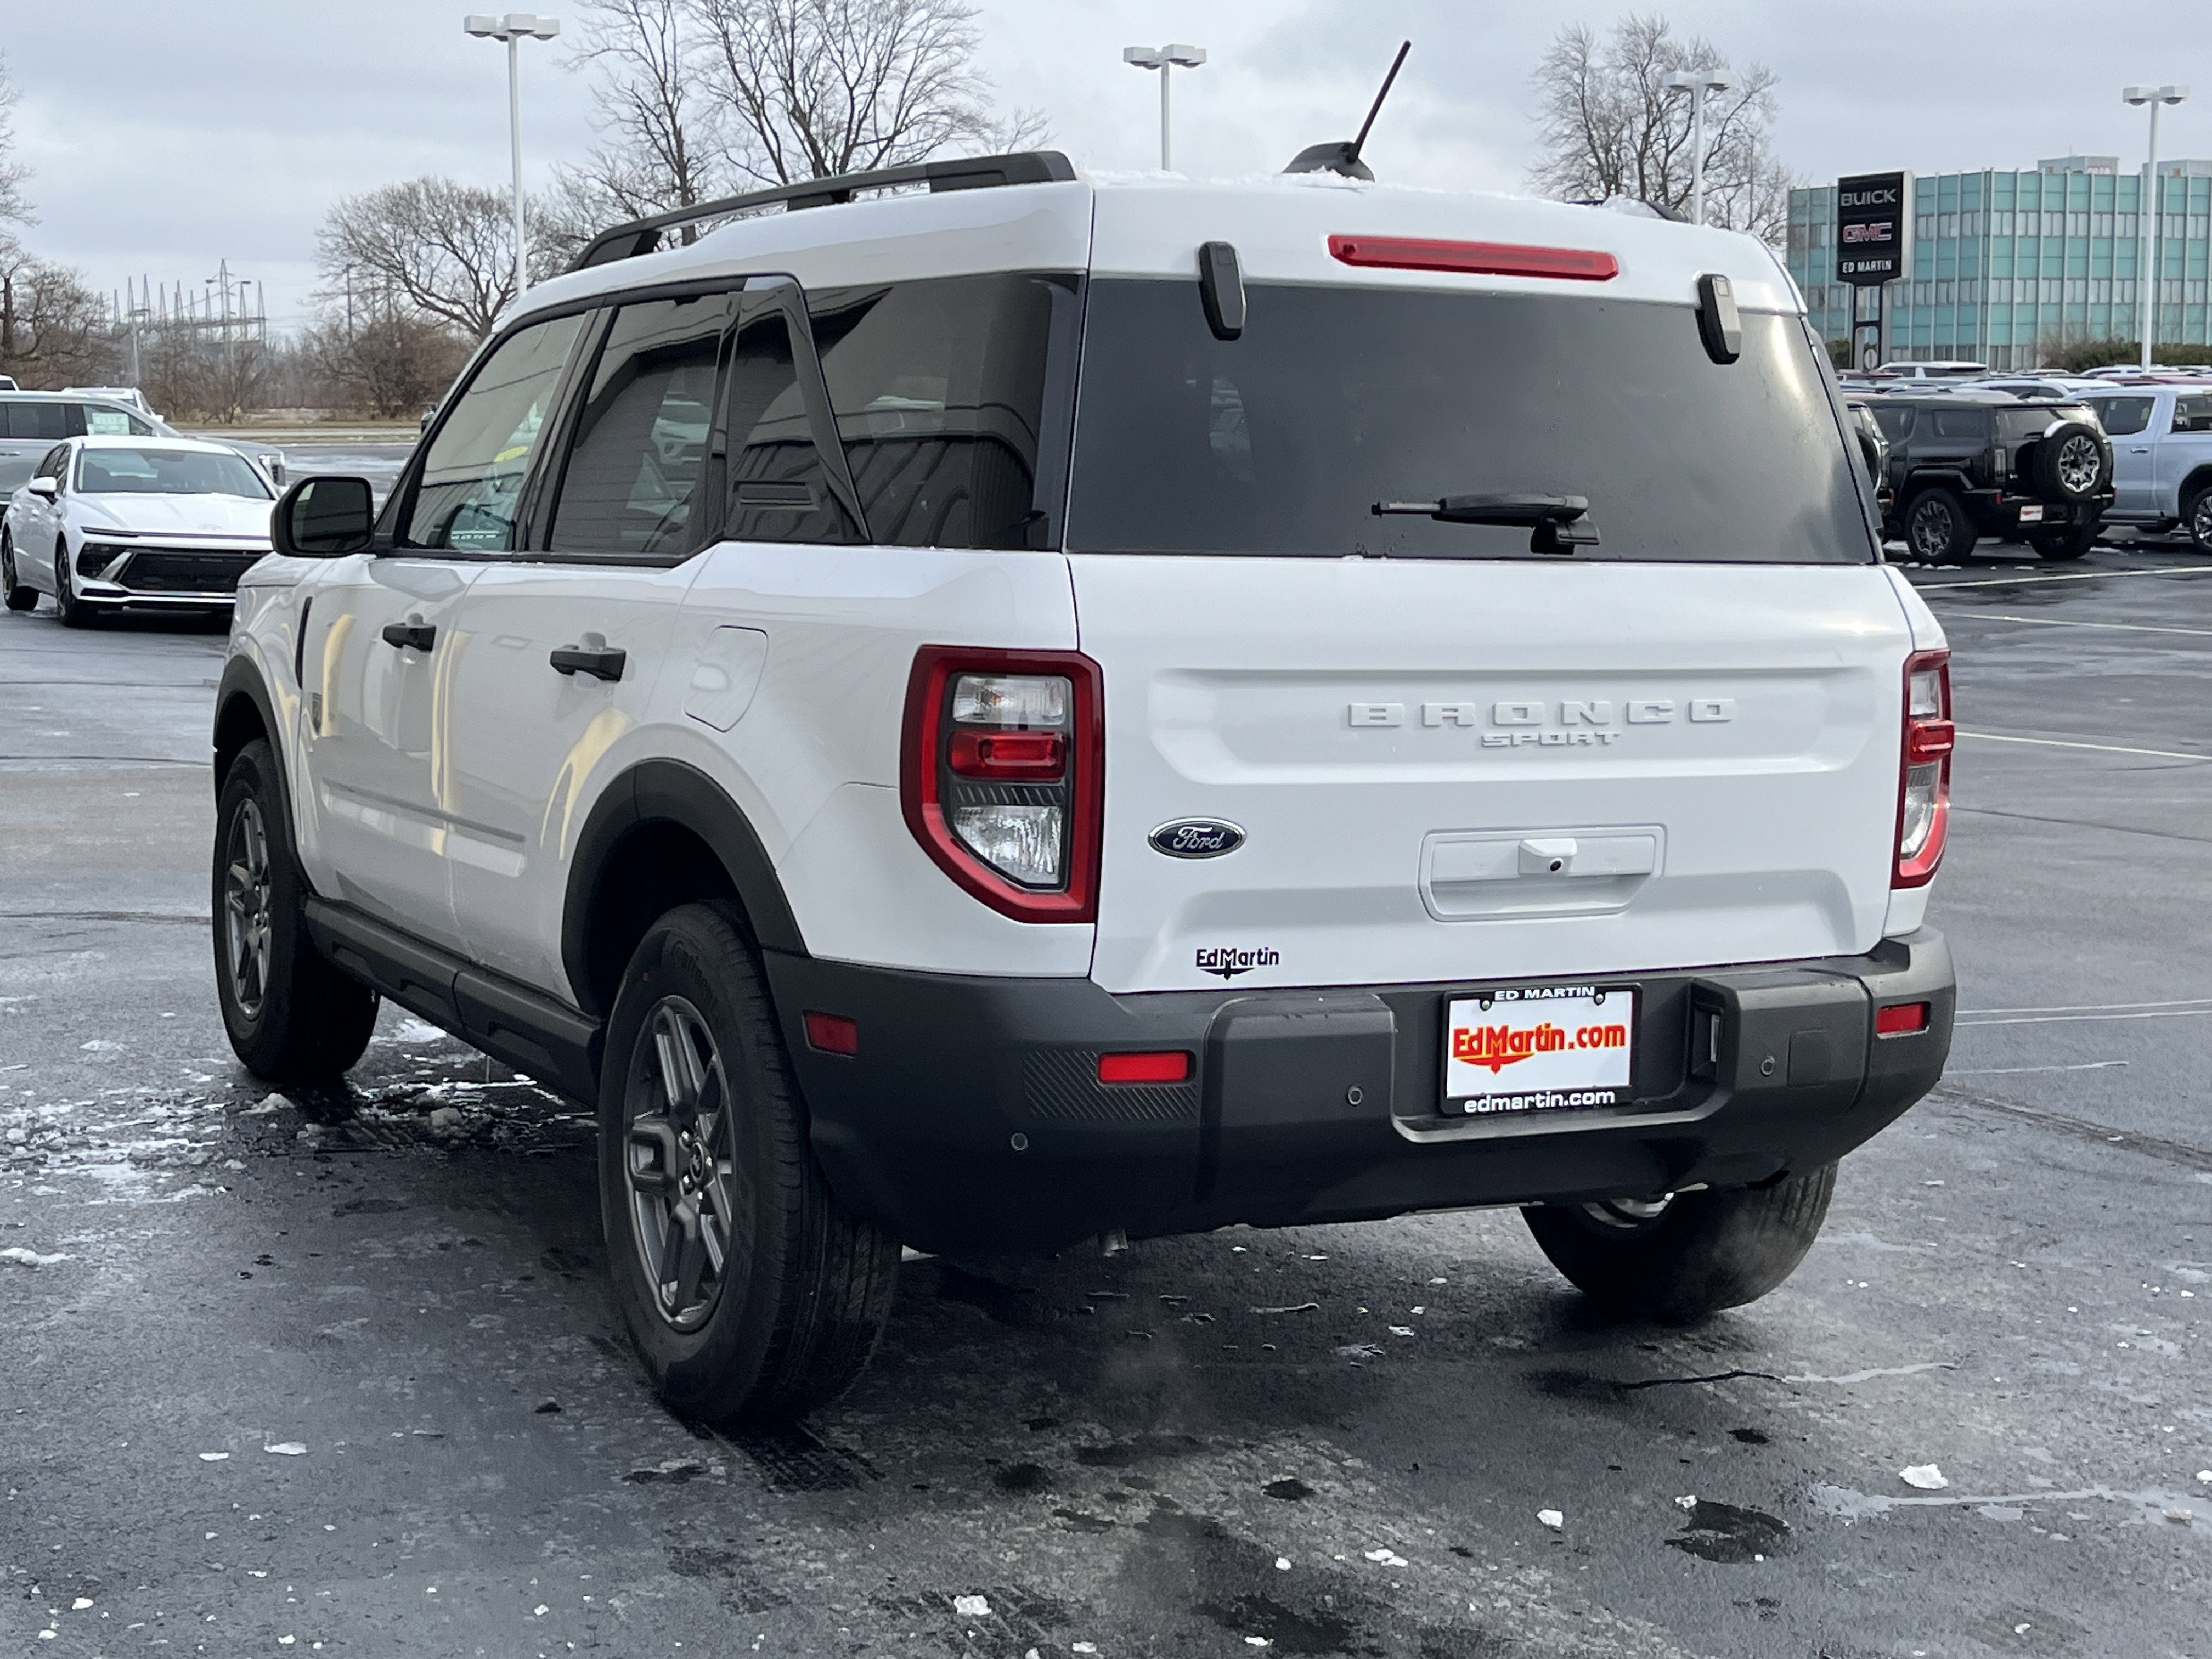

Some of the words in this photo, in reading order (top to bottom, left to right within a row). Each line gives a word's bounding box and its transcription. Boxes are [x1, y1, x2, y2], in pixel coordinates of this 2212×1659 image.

[1840, 189, 1897, 207] BUICK
[1843, 222, 1893, 244] GMC
[1842, 262, 1855, 274] ED
[1857, 259, 1892, 273] MARTIN
[1347, 698, 1736, 727] BRONCO
[1480, 731, 1622, 747] SPORT
[1172, 826, 1226, 850] Ford
[1494, 990, 1519, 1002] ED
[1523, 986, 1595, 1000] MARTIN
[1463, 1090, 1616, 1114] edmartin.com
